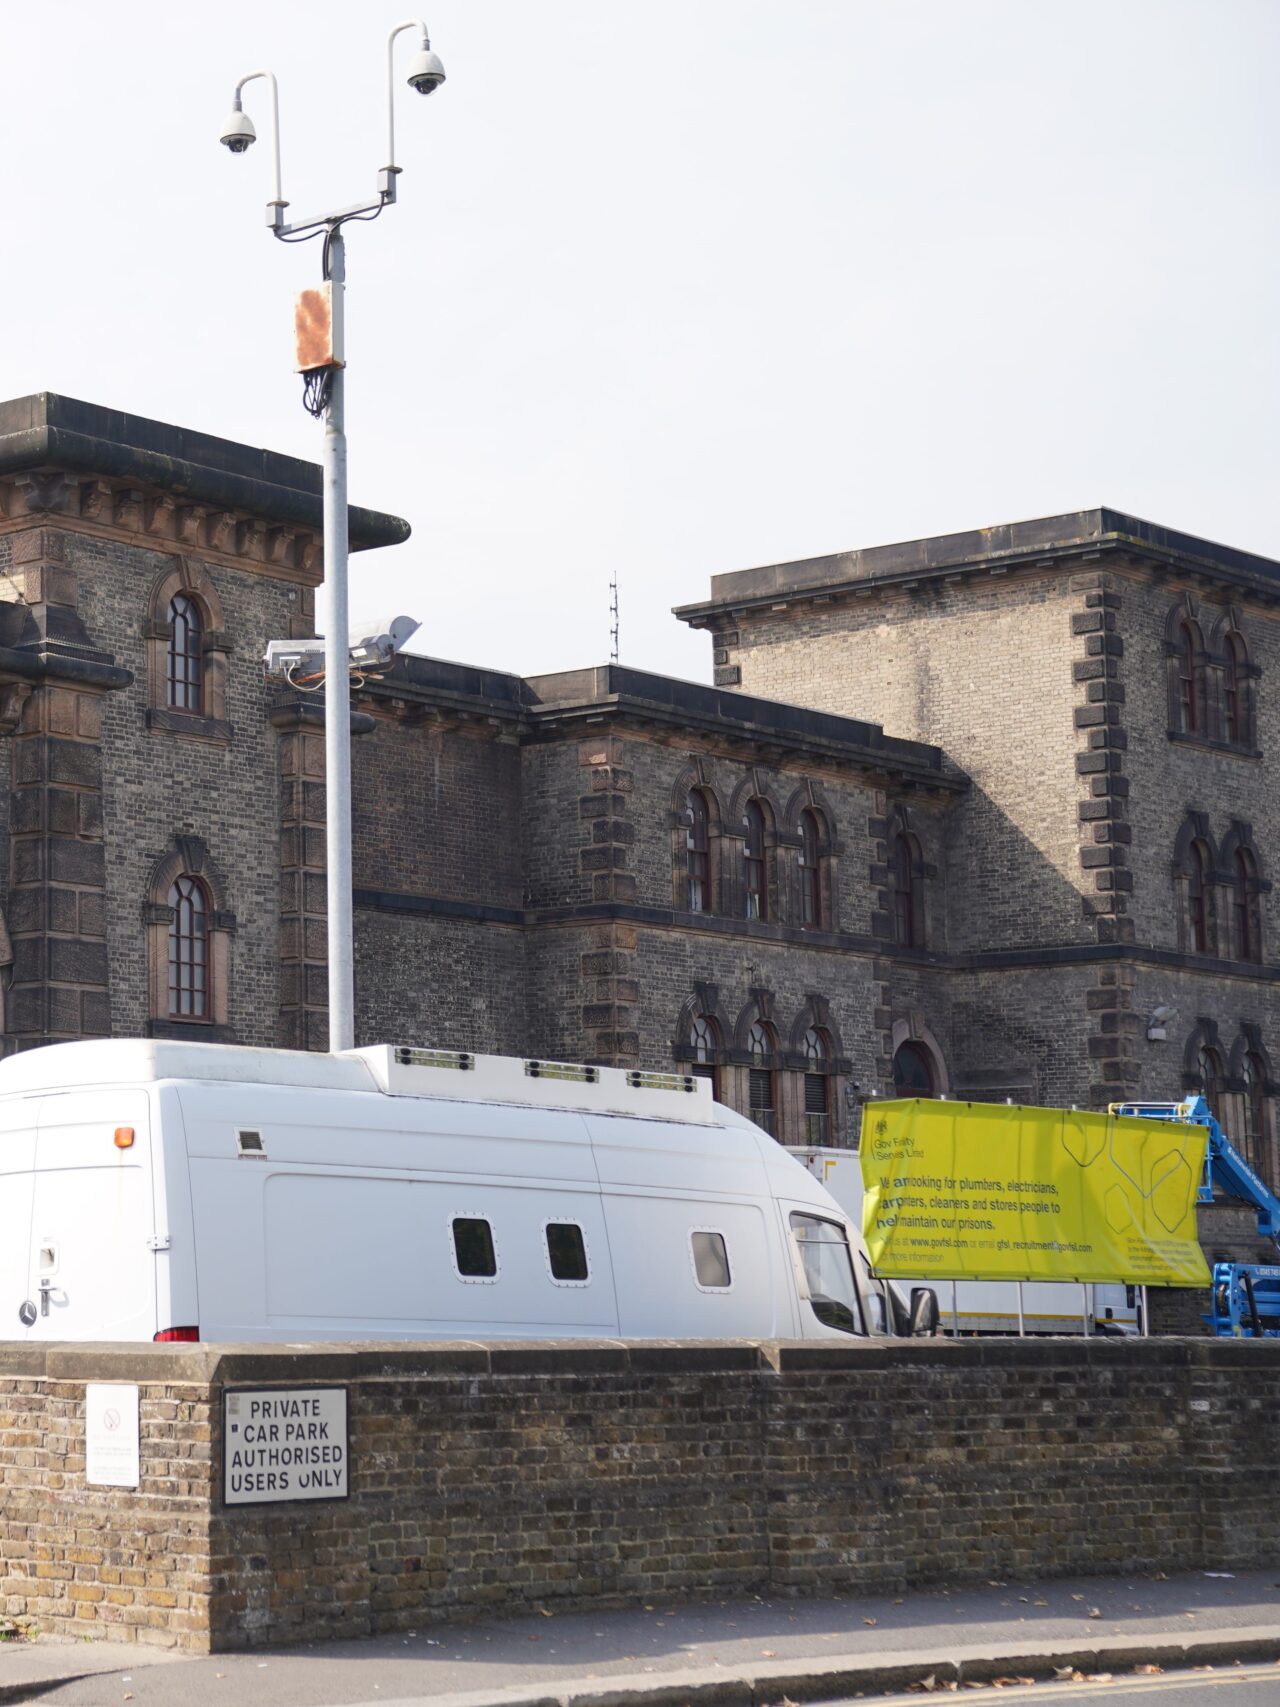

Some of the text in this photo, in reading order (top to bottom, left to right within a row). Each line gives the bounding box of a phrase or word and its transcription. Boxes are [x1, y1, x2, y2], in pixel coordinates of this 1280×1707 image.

[874, 1139, 892, 1149] Gov
[893, 1177, 908, 1187] ar
[908, 1175, 941, 1191] ooking
[944, 1176, 956, 1189] for
[960, 1177, 1005, 1193] plumbers,
[1007, 1180, 1059, 1196] electricians,
[929, 1196, 969, 1210] cleaners
[972, 1199, 987, 1210] and
[990, 1199, 1018, 1212] stores
[1020, 1201, 1050, 1215] people
[1051, 1202, 1061, 1214] to
[876, 1213, 995, 1231] hel maintain our prisons.
[251, 1399, 321, 1419] PRIVATE
[244, 1422, 329, 1443] CAR PARK
[231, 1445, 343, 1468] AUTHORISED
[231, 1472, 289, 1492] USERS
